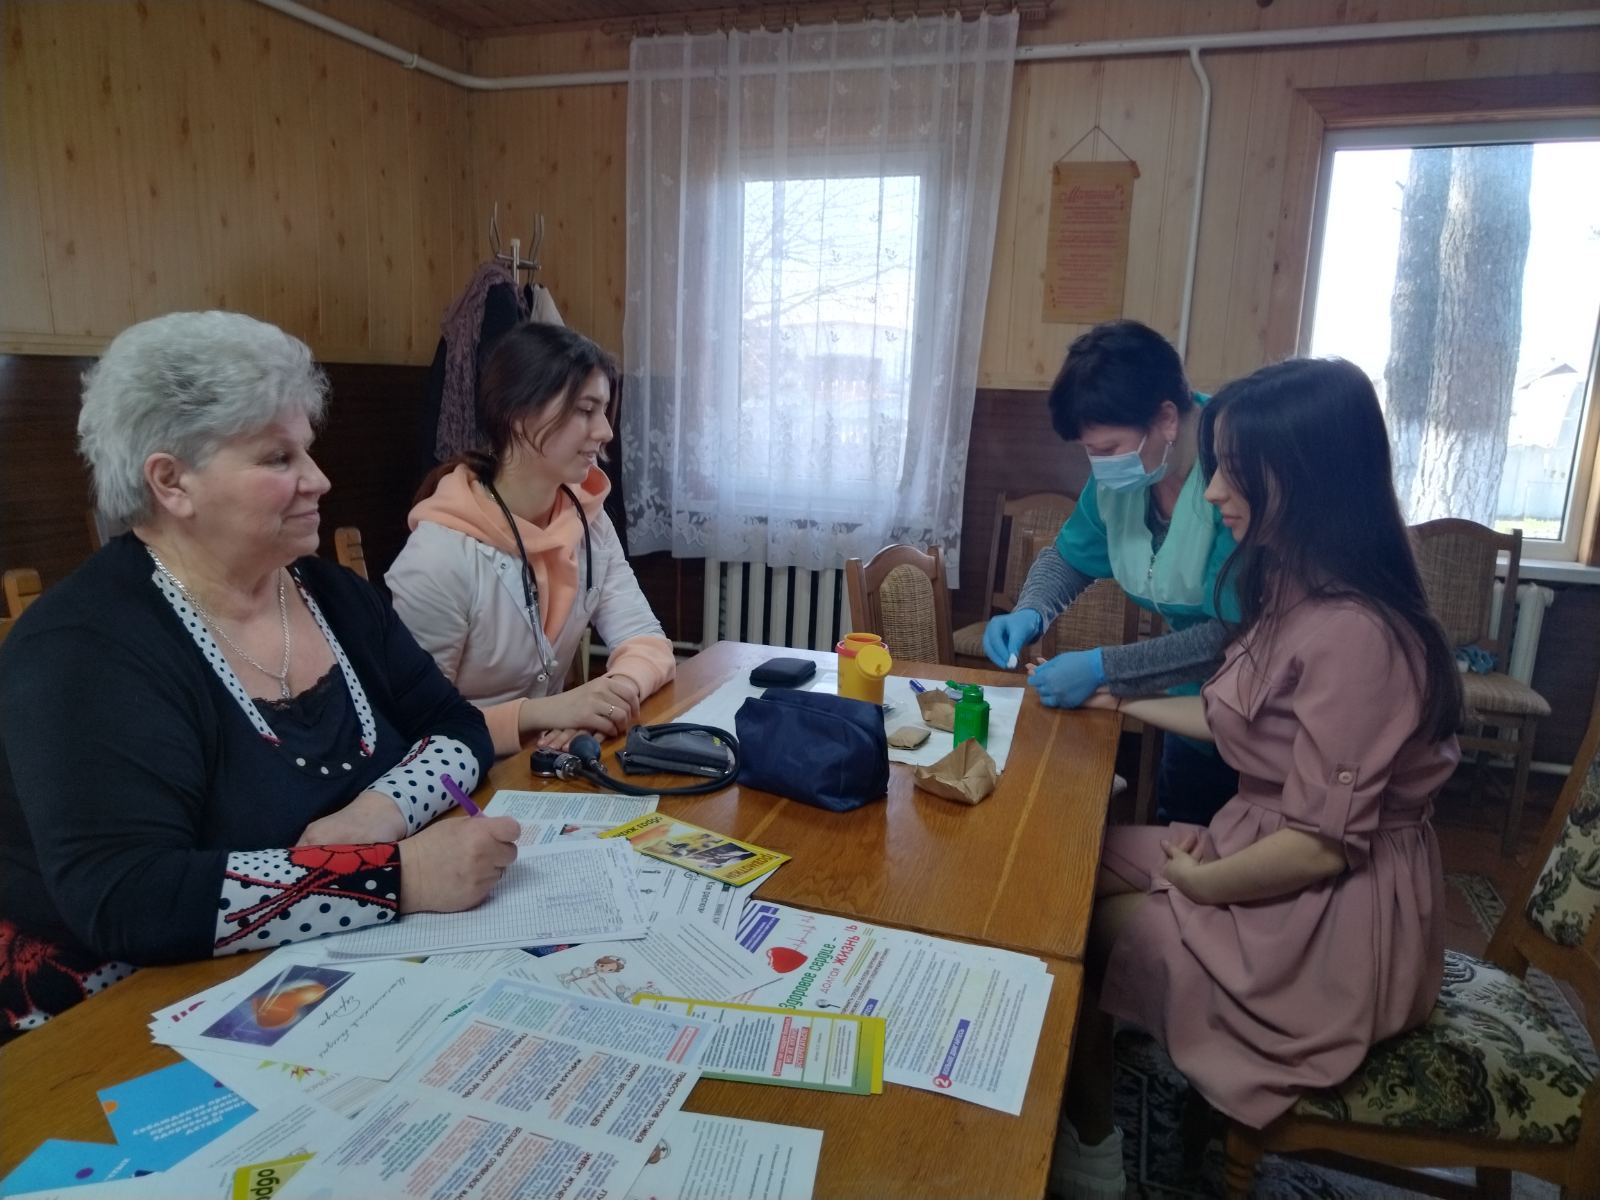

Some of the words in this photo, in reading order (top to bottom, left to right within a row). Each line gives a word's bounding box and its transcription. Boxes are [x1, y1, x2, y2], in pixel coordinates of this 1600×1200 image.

[779, 971, 817, 1010] Здоровое
[808, 941, 836, 971] сердце
[934, 1076, 949, 1088] 2
[193, 1096, 240, 1119] сохрани
[207, 1092, 236, 1107] прос
